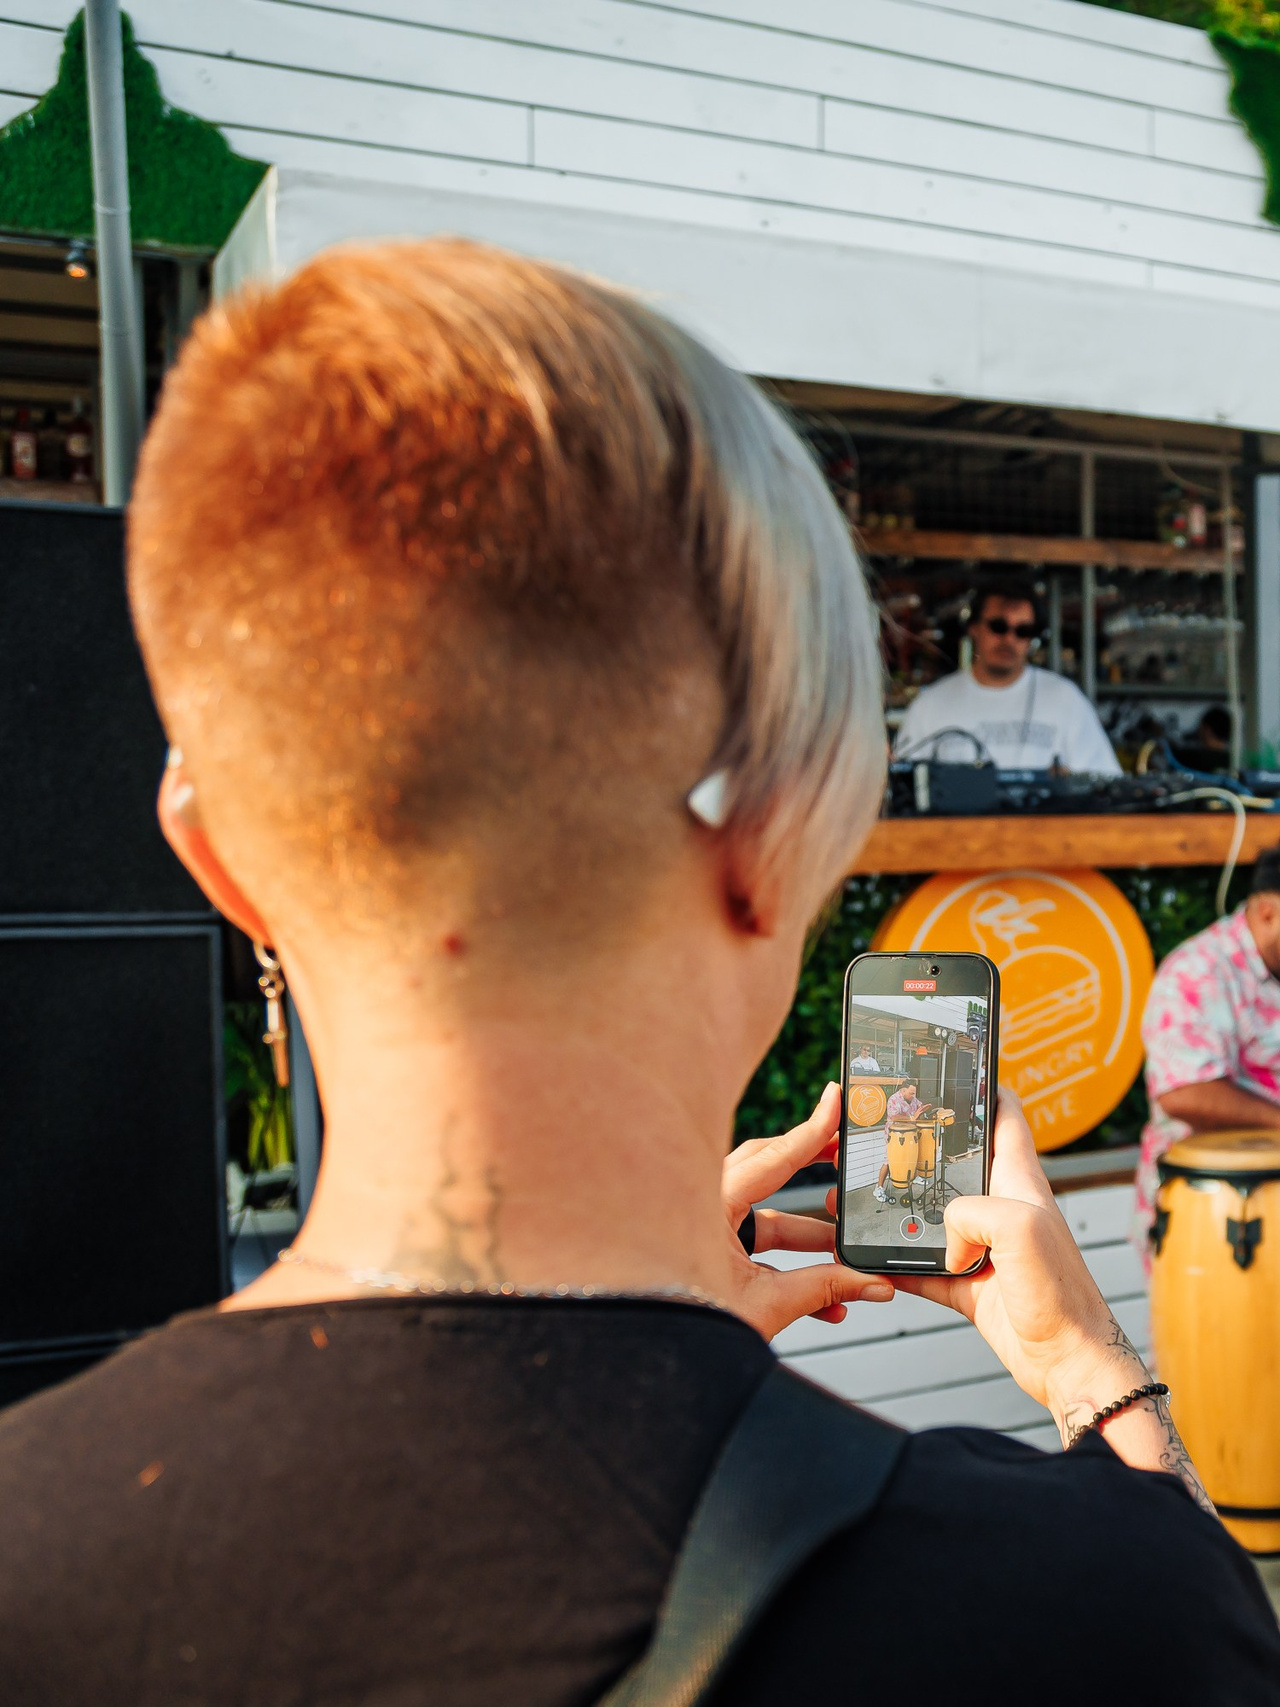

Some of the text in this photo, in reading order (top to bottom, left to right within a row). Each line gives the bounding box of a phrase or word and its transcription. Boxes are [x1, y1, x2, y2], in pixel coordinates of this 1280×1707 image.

[905, 982, 934, 990] 00:00:22
[1002, 1039, 1096, 1091] UNGRY
[1032, 1089, 1077, 1130] IVE
